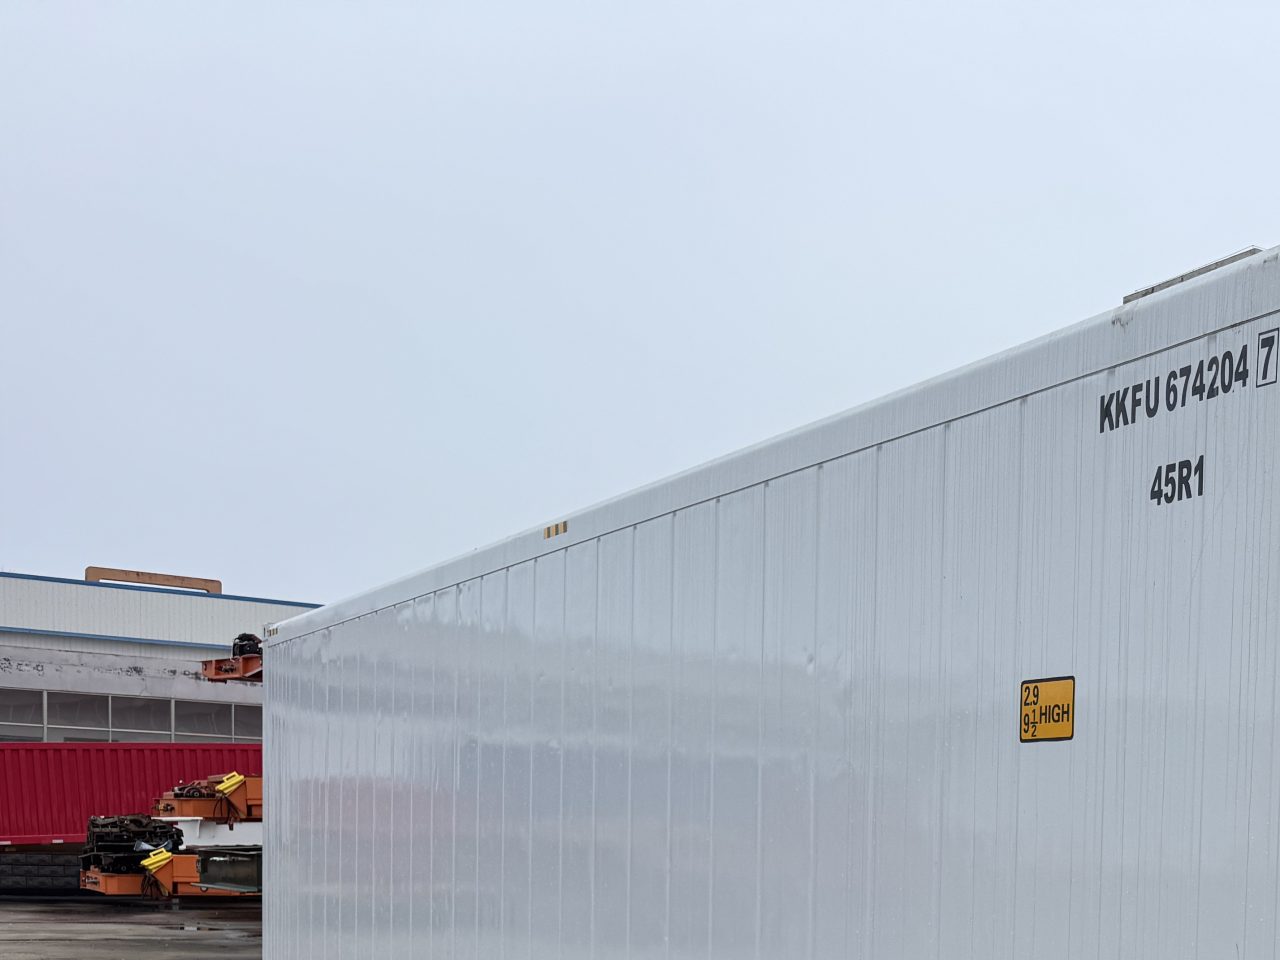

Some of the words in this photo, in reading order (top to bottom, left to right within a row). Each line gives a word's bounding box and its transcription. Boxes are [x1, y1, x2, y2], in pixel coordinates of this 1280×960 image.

[1099, 376, 1160, 434] KKFU
[1165, 344, 1249, 412] 674204
[1259, 334, 1276, 382] 7
[1150, 455, 1204, 506] 45R1
[1024, 685, 1039, 706] 2.9
[1039, 704, 1070, 724] HIGH
